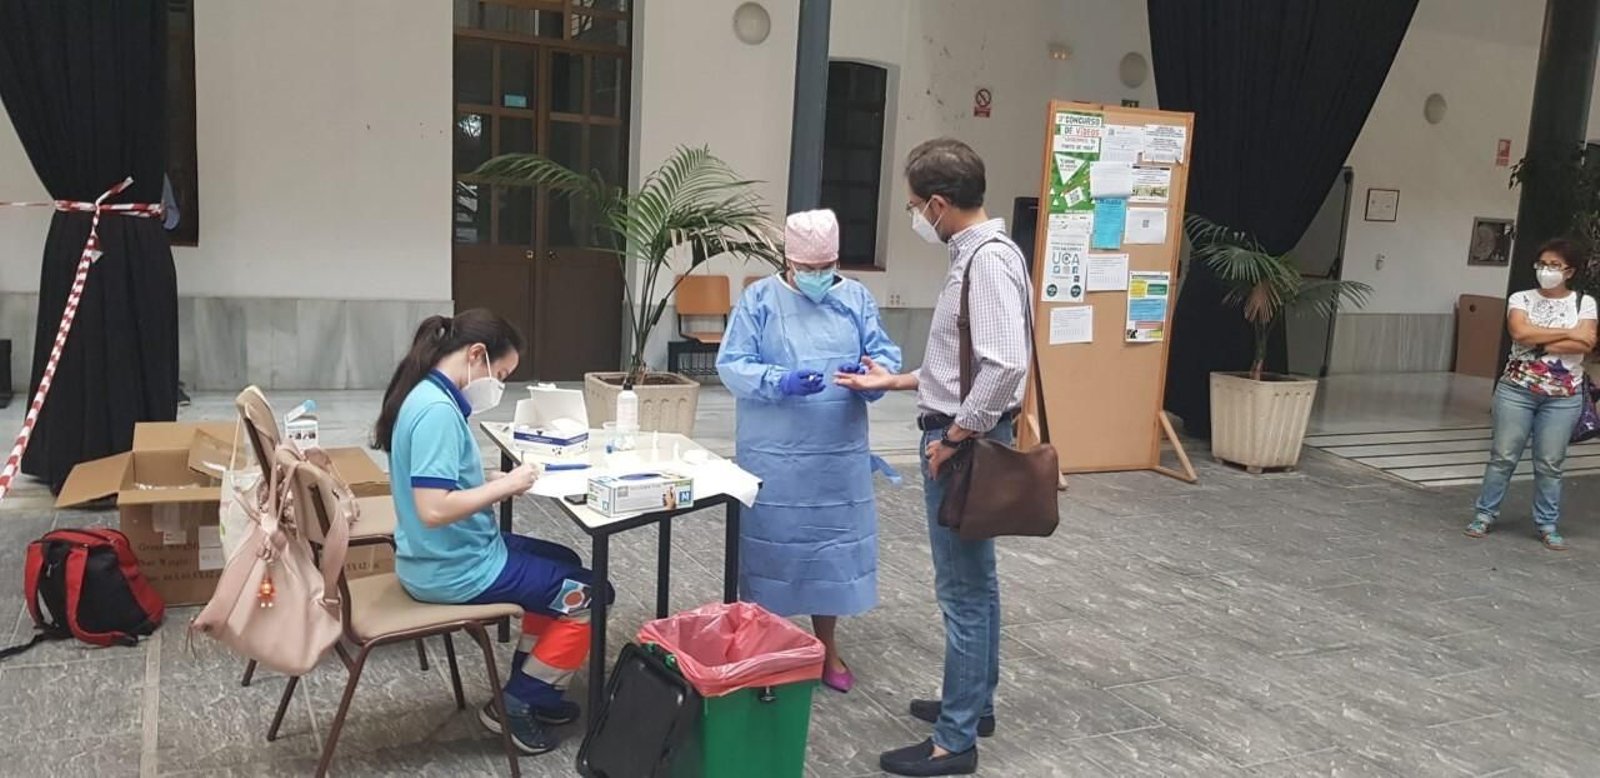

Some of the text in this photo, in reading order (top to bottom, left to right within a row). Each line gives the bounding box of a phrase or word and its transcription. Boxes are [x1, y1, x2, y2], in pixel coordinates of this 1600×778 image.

[1066, 115, 1100, 125] CONCURSO
[1065, 126, 1072, 134] DE
[1052, 251, 1080, 265] UCA
